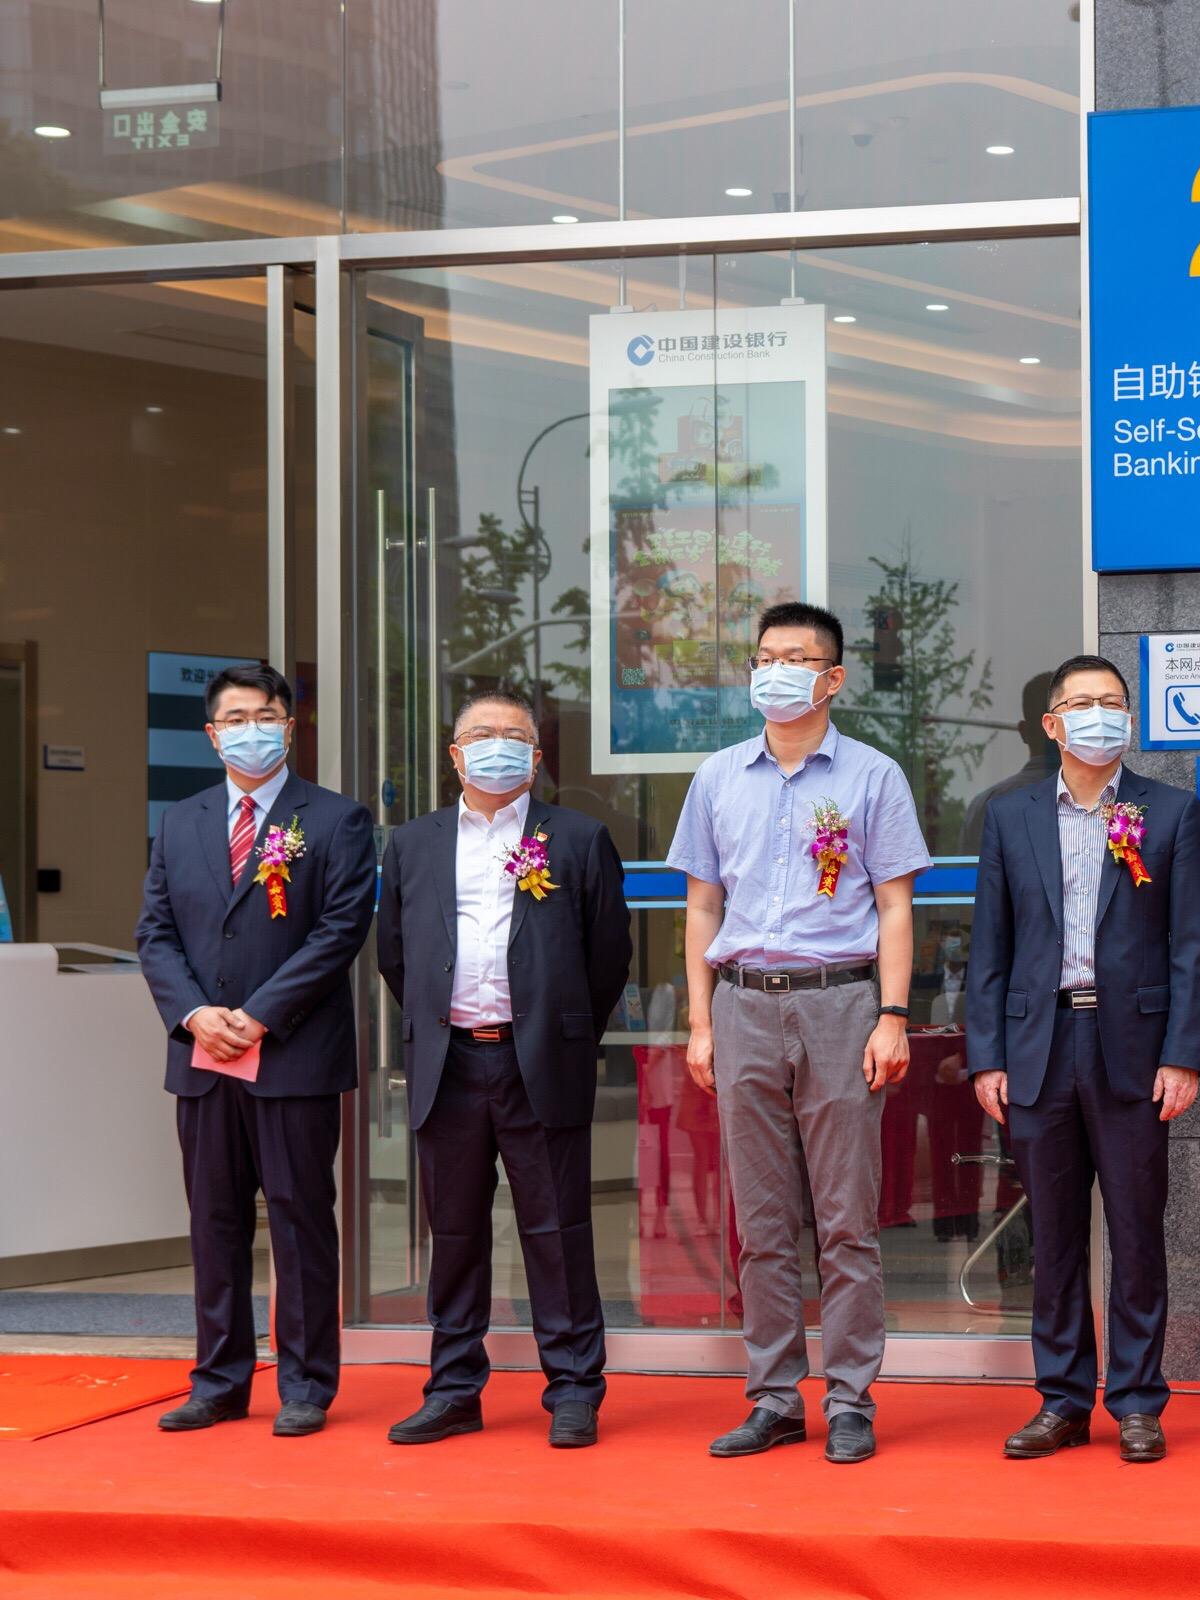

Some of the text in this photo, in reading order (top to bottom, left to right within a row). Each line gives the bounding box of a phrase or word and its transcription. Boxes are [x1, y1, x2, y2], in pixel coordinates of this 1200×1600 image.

[658, 331, 788, 352] 中国建设银行
[658, 353, 685, 363] China
[747, 349, 771, 358] Bank
